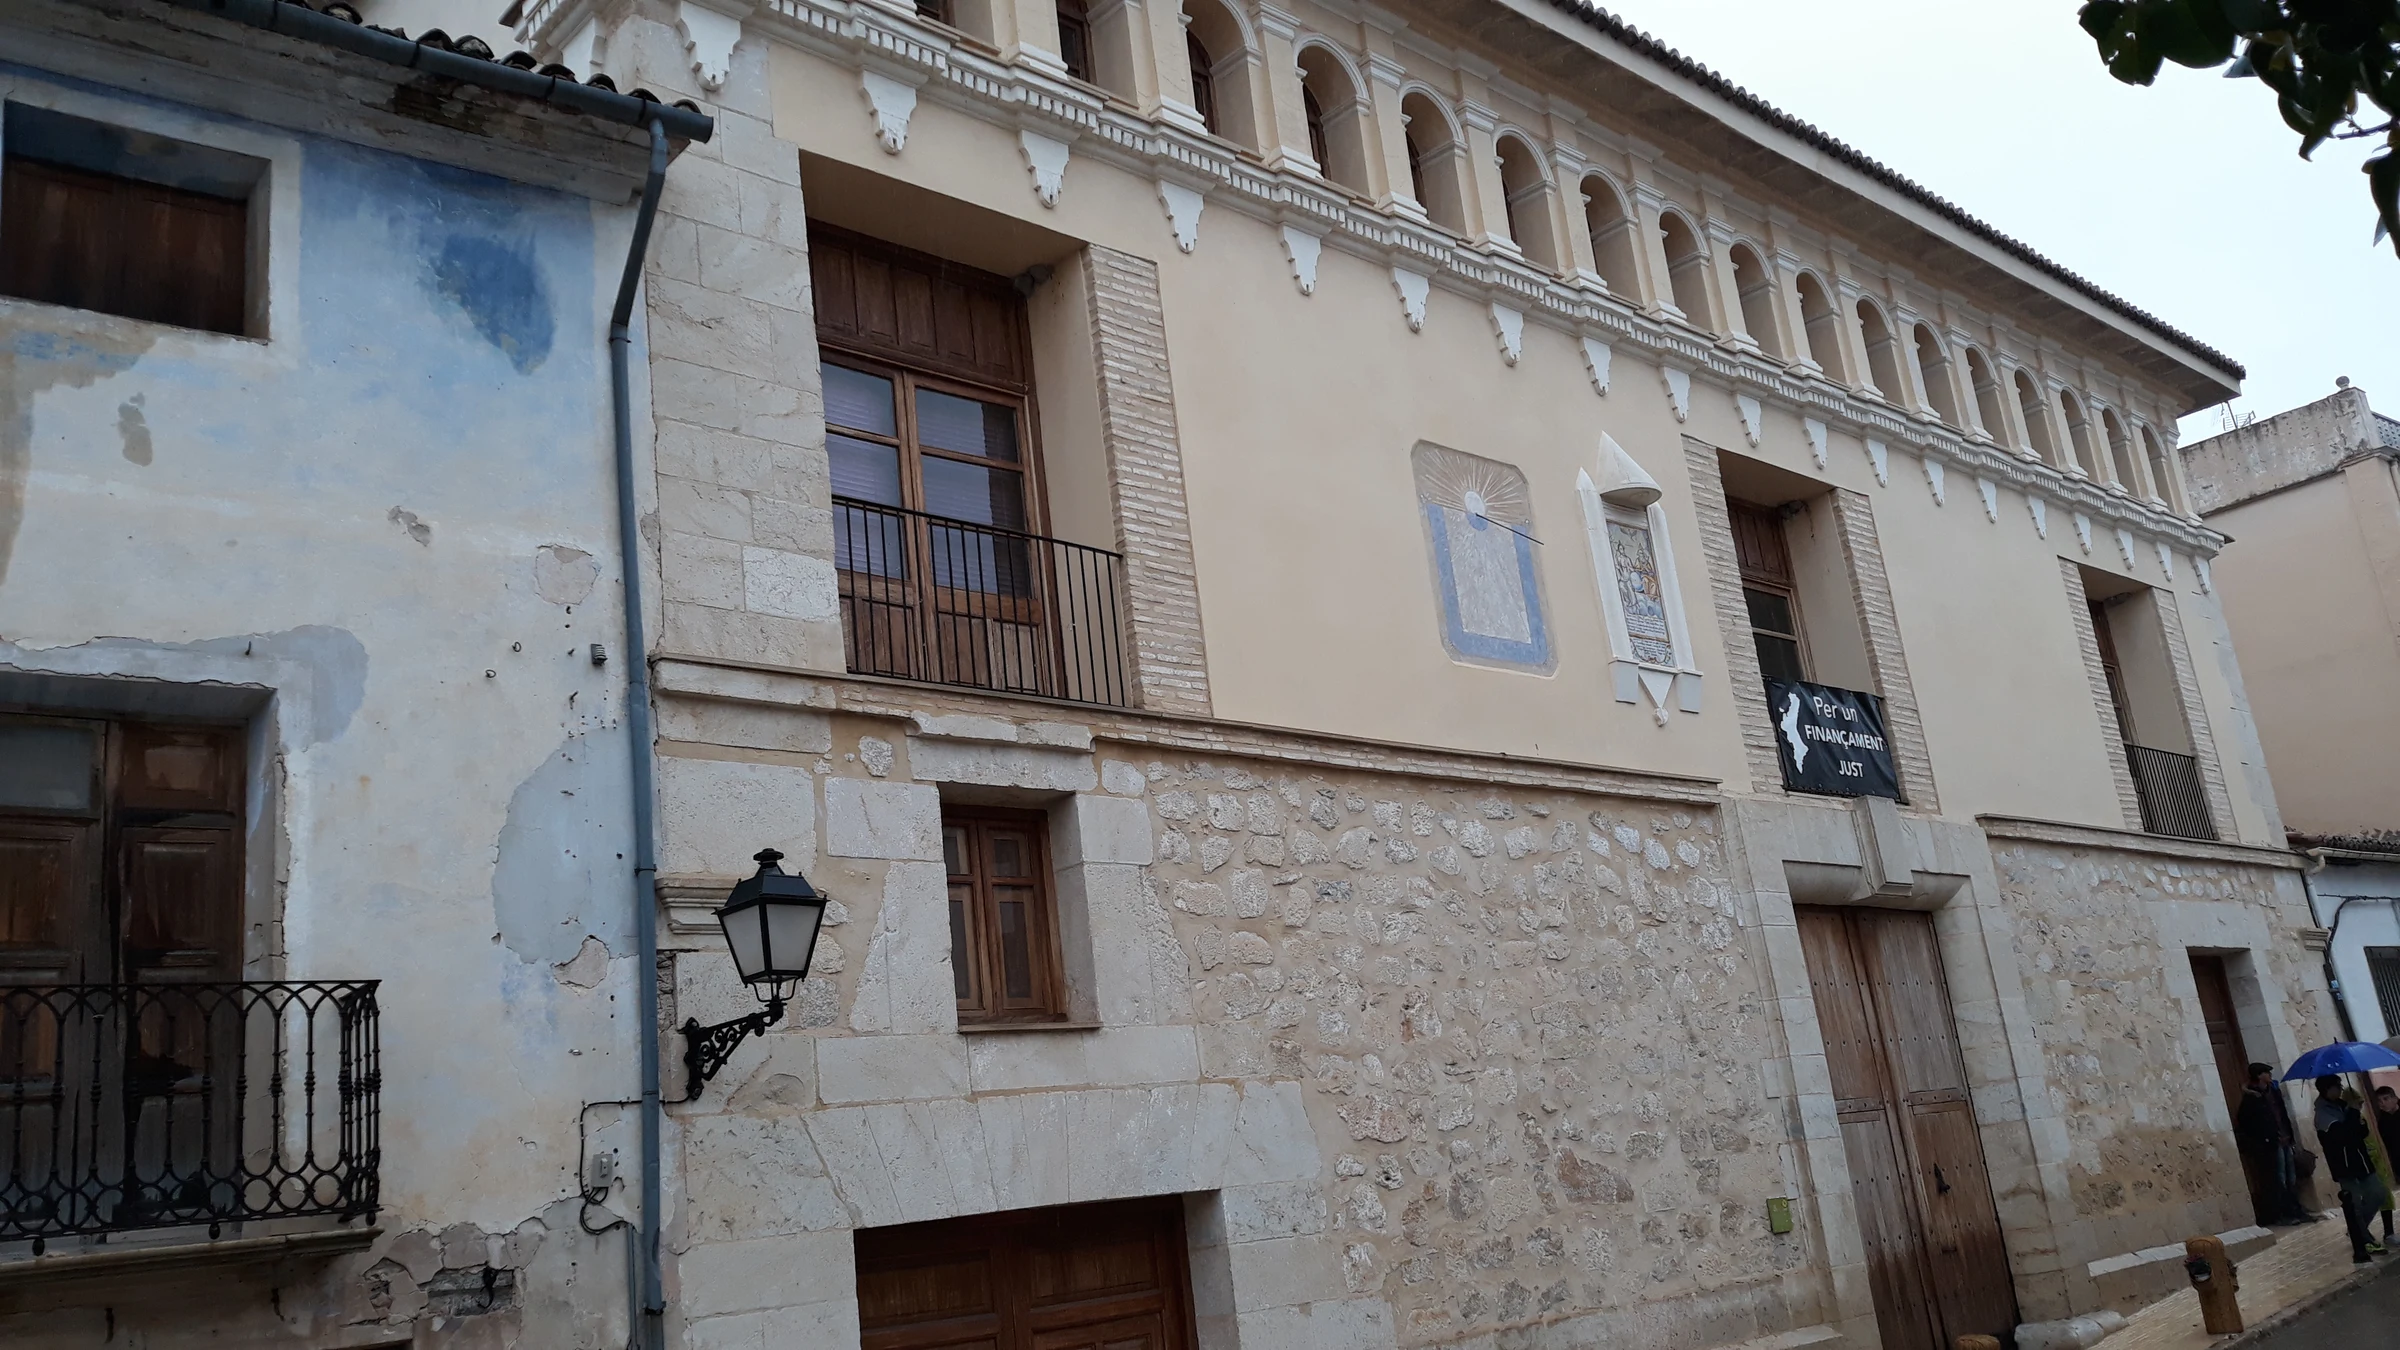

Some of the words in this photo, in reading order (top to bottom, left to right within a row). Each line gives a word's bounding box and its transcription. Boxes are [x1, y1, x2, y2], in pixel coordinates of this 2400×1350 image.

[1813, 696, 1838, 718] Per
[1841, 706, 1858, 723] un
[1804, 724, 1884, 752] FINANÇAMENT
[1839, 760, 1864, 778] JUST
